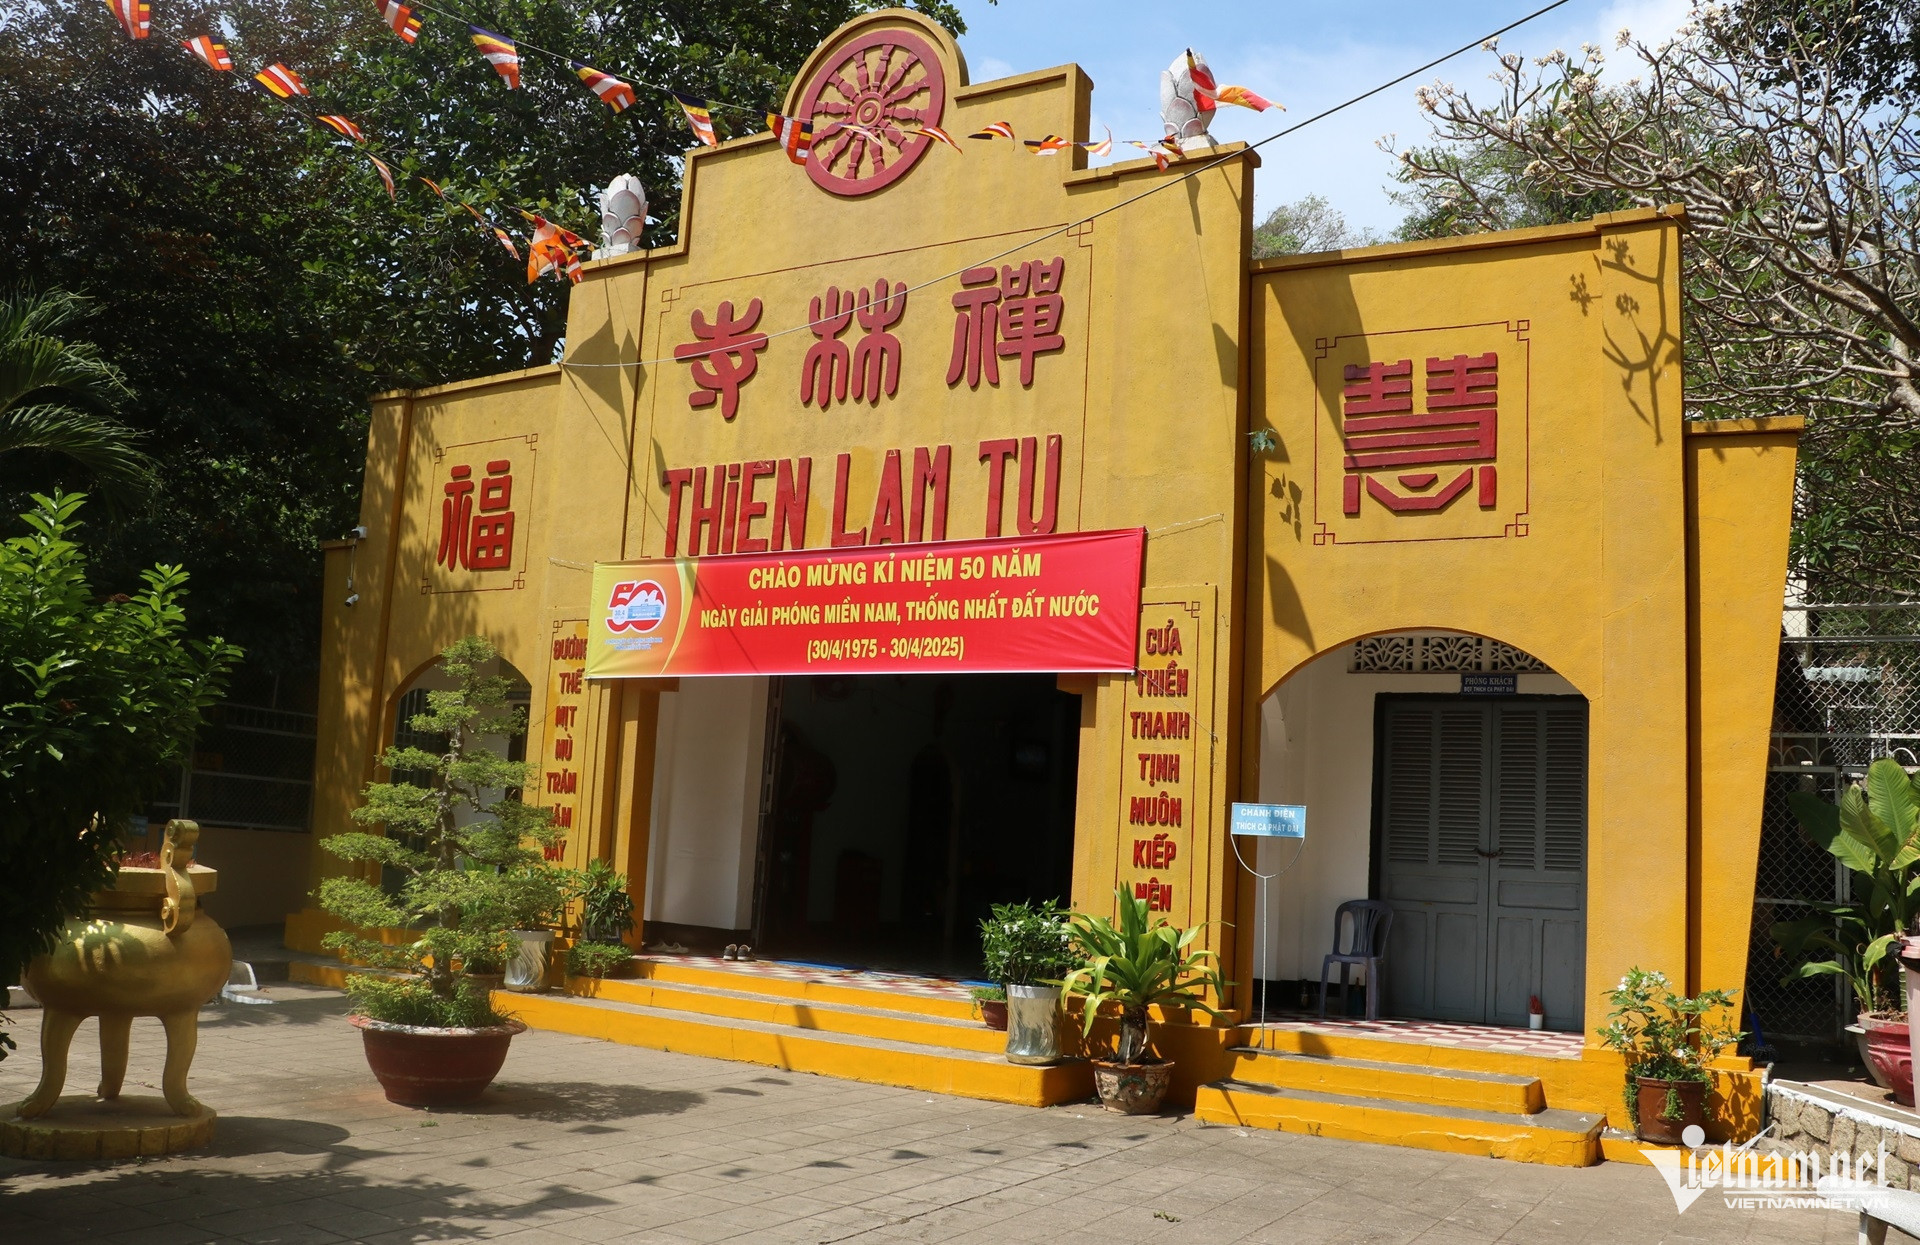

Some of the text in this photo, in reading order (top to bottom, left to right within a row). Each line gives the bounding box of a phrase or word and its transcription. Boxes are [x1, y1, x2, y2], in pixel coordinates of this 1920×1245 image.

[437, 459, 515, 572] 福
[749, 547, 1041, 590] CHÀO MỪNG KỈ NIỆM 50 NĂM
[701, 588, 1100, 628] NGÀY GIẢI PHÓNG MIỀN NAM, THỐNG NHẤT ĐẤT NƯỚC
[807, 639, 878, 664] (30/4/1975
[890, 636, 964, 661] 30/4/2025)
[1146, 618, 1182, 654] CỬA
[559, 668, 585, 694] THẾ
[555, 706, 577, 731] MỊT
[1130, 711, 1190, 739] THANH
[555, 733, 573, 760] MÙ
[546, 768, 577, 794] TRĂM
[1138, 754, 1180, 787] TỊNH
[546, 803, 572, 829] ĂM
[1129, 791, 1182, 827] MUÔN
[1241, 806, 1295, 820] CHÁNH ĐIỆN
[1257, 822, 1267, 831] CA
[1268, 822, 1286, 833] PHẬT
[1133, 833, 1176, 869] KIẾP
[1135, 877, 1172, 912] NÊN
